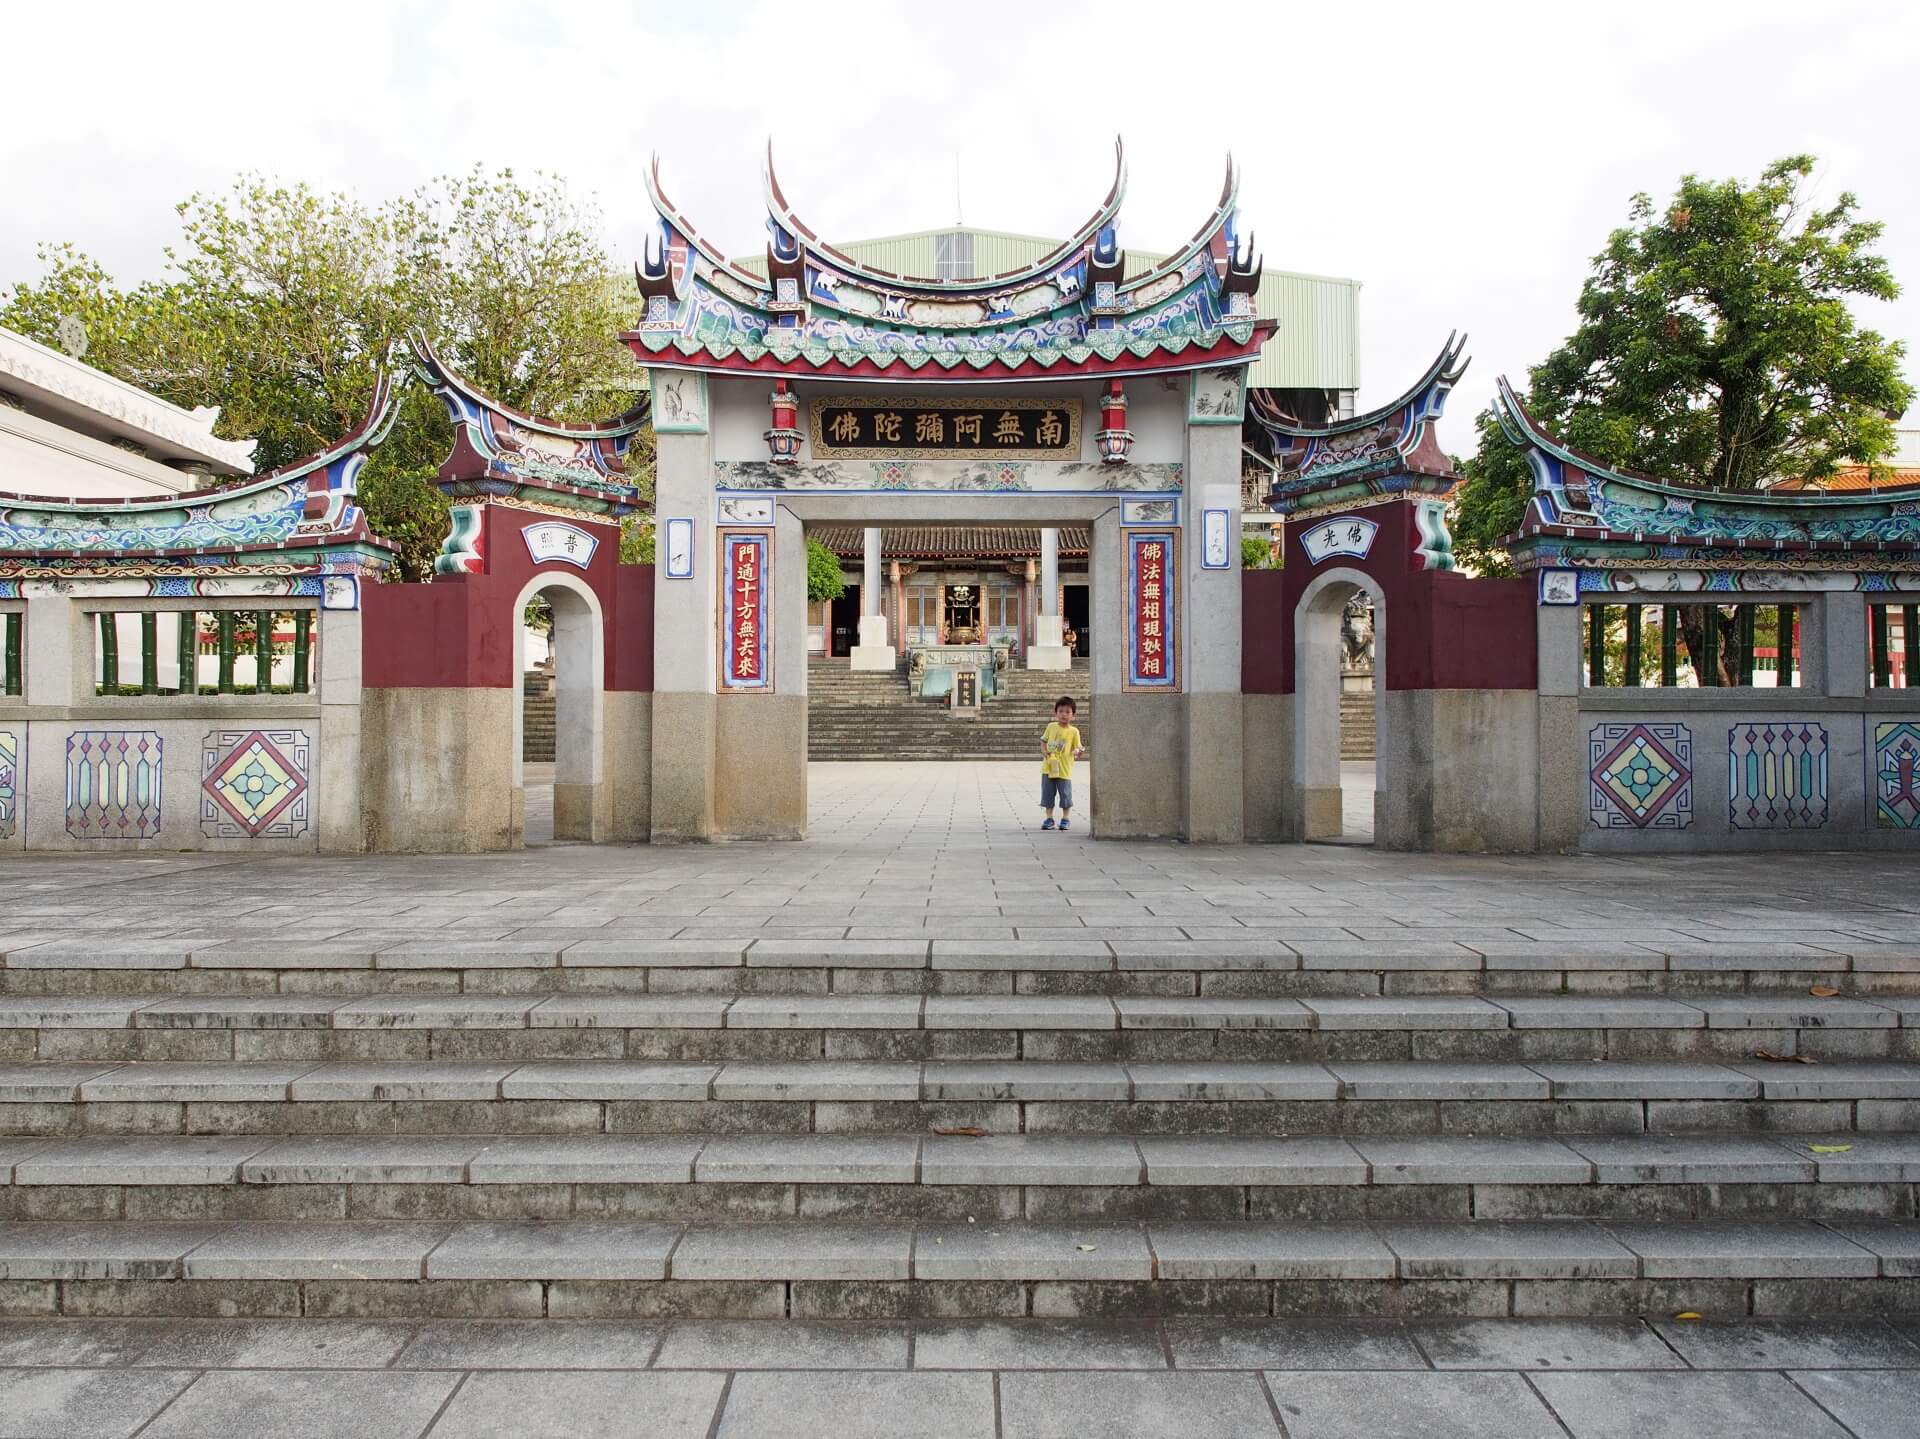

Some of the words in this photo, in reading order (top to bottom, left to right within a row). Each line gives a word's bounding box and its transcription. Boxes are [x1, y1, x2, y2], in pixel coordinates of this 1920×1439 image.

[737, 543, 757, 677] 門通十方無去來
[1141, 543, 1162, 675] 佛法無相現妙相
